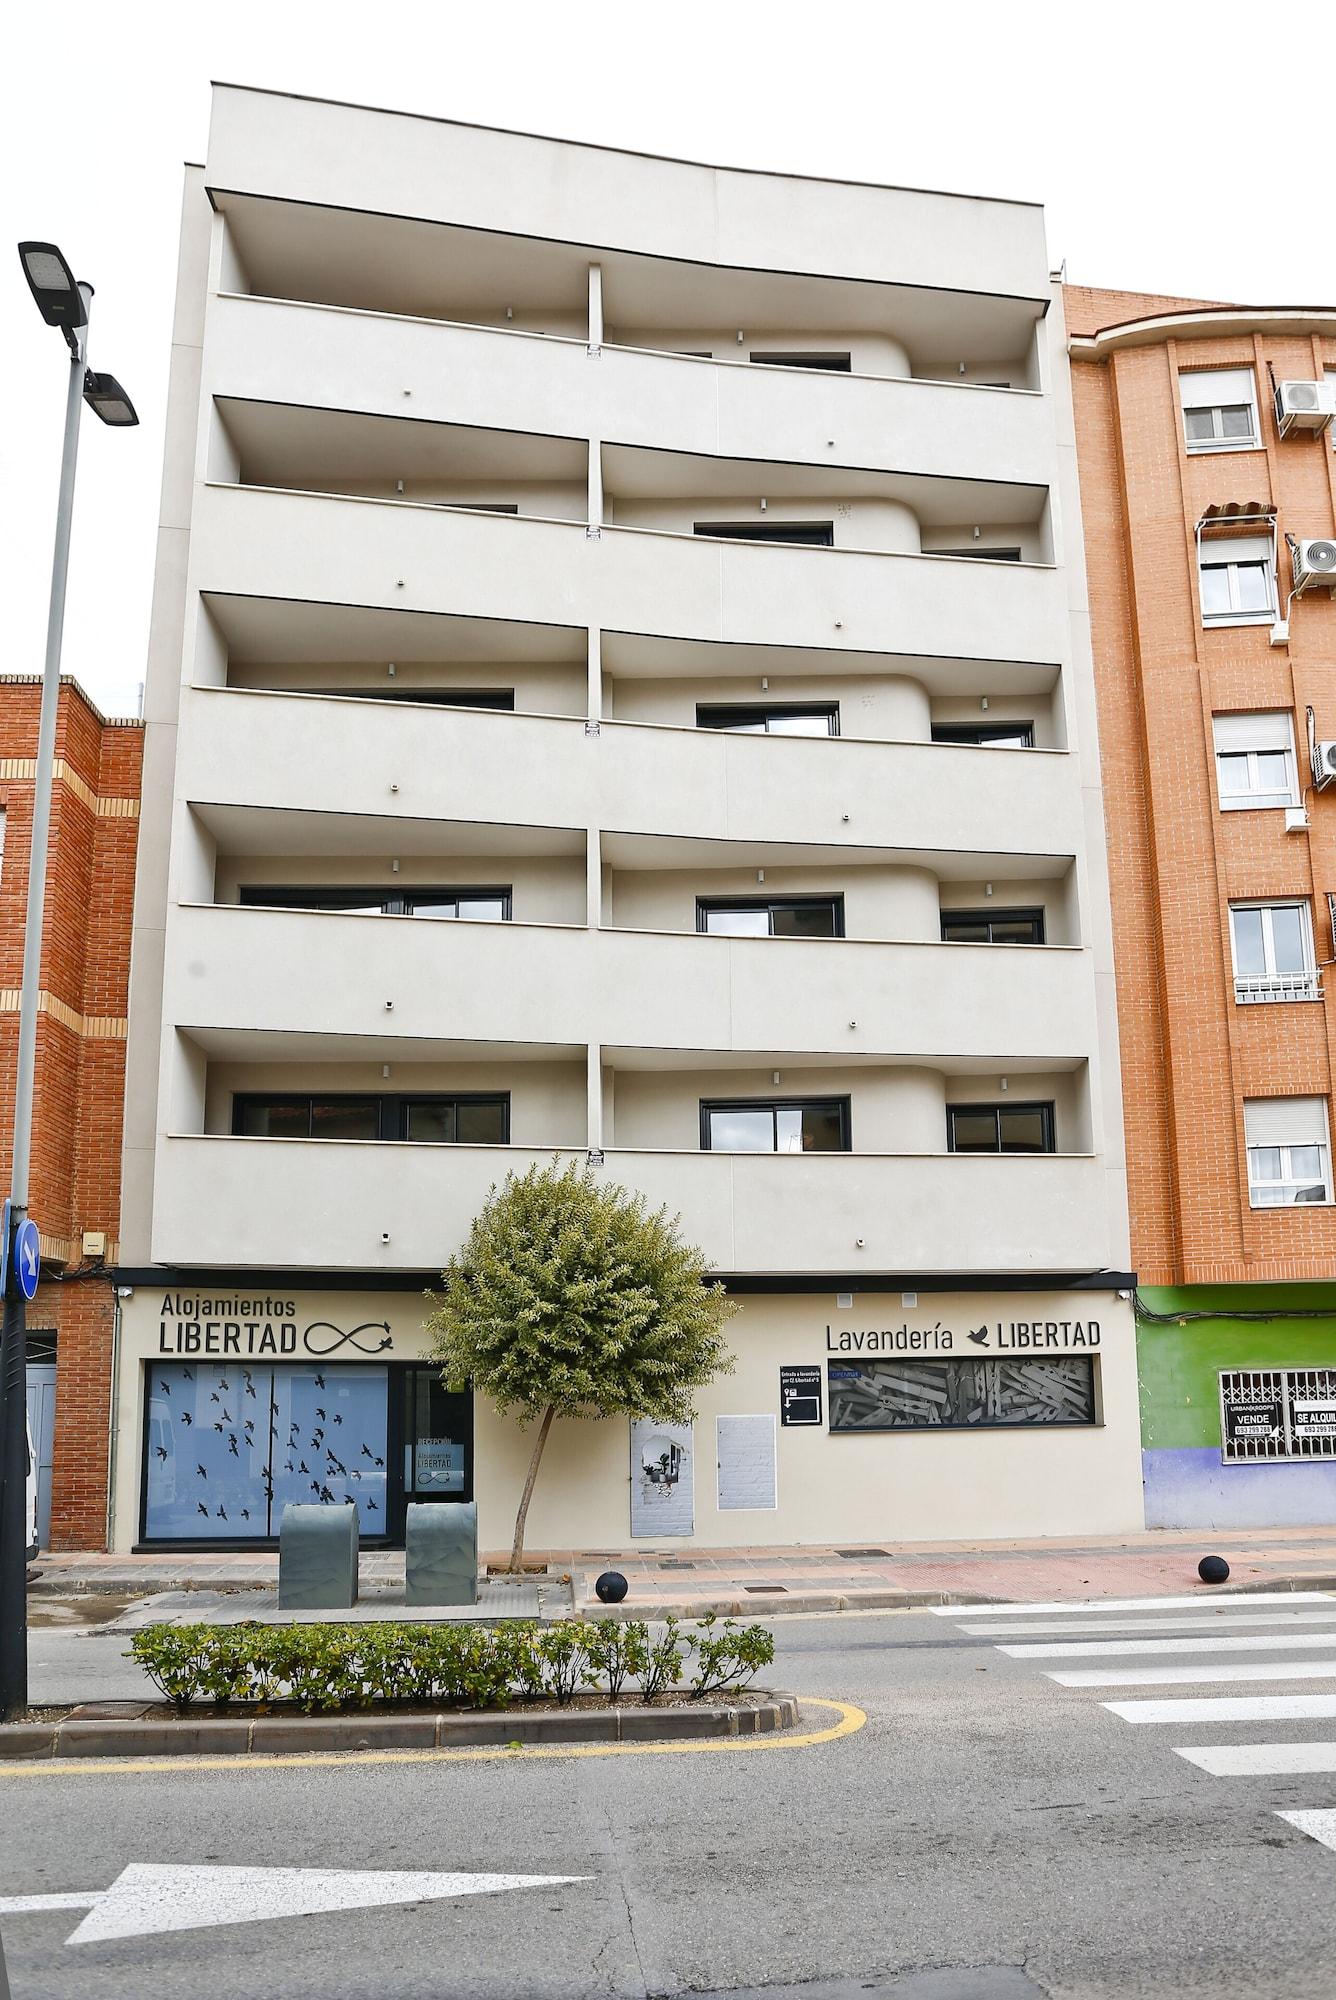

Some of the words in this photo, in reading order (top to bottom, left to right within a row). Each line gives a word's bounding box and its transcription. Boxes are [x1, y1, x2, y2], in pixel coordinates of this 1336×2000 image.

[160, 1293, 296, 1321] Alojamientos
[159, 1322, 297, 1354] LIBERTAD
[826, 1322, 953, 1351] Lavandería
[997, 1321, 1101, 1348] LIBERTAD
[1237, 1415, 1269, 1424] VENDE
[1297, 1413, 1309, 1423] SE
[417, 1436, 452, 1446] RECEPCIÓN
[417, 1459, 452, 1468] LIBERTAD
